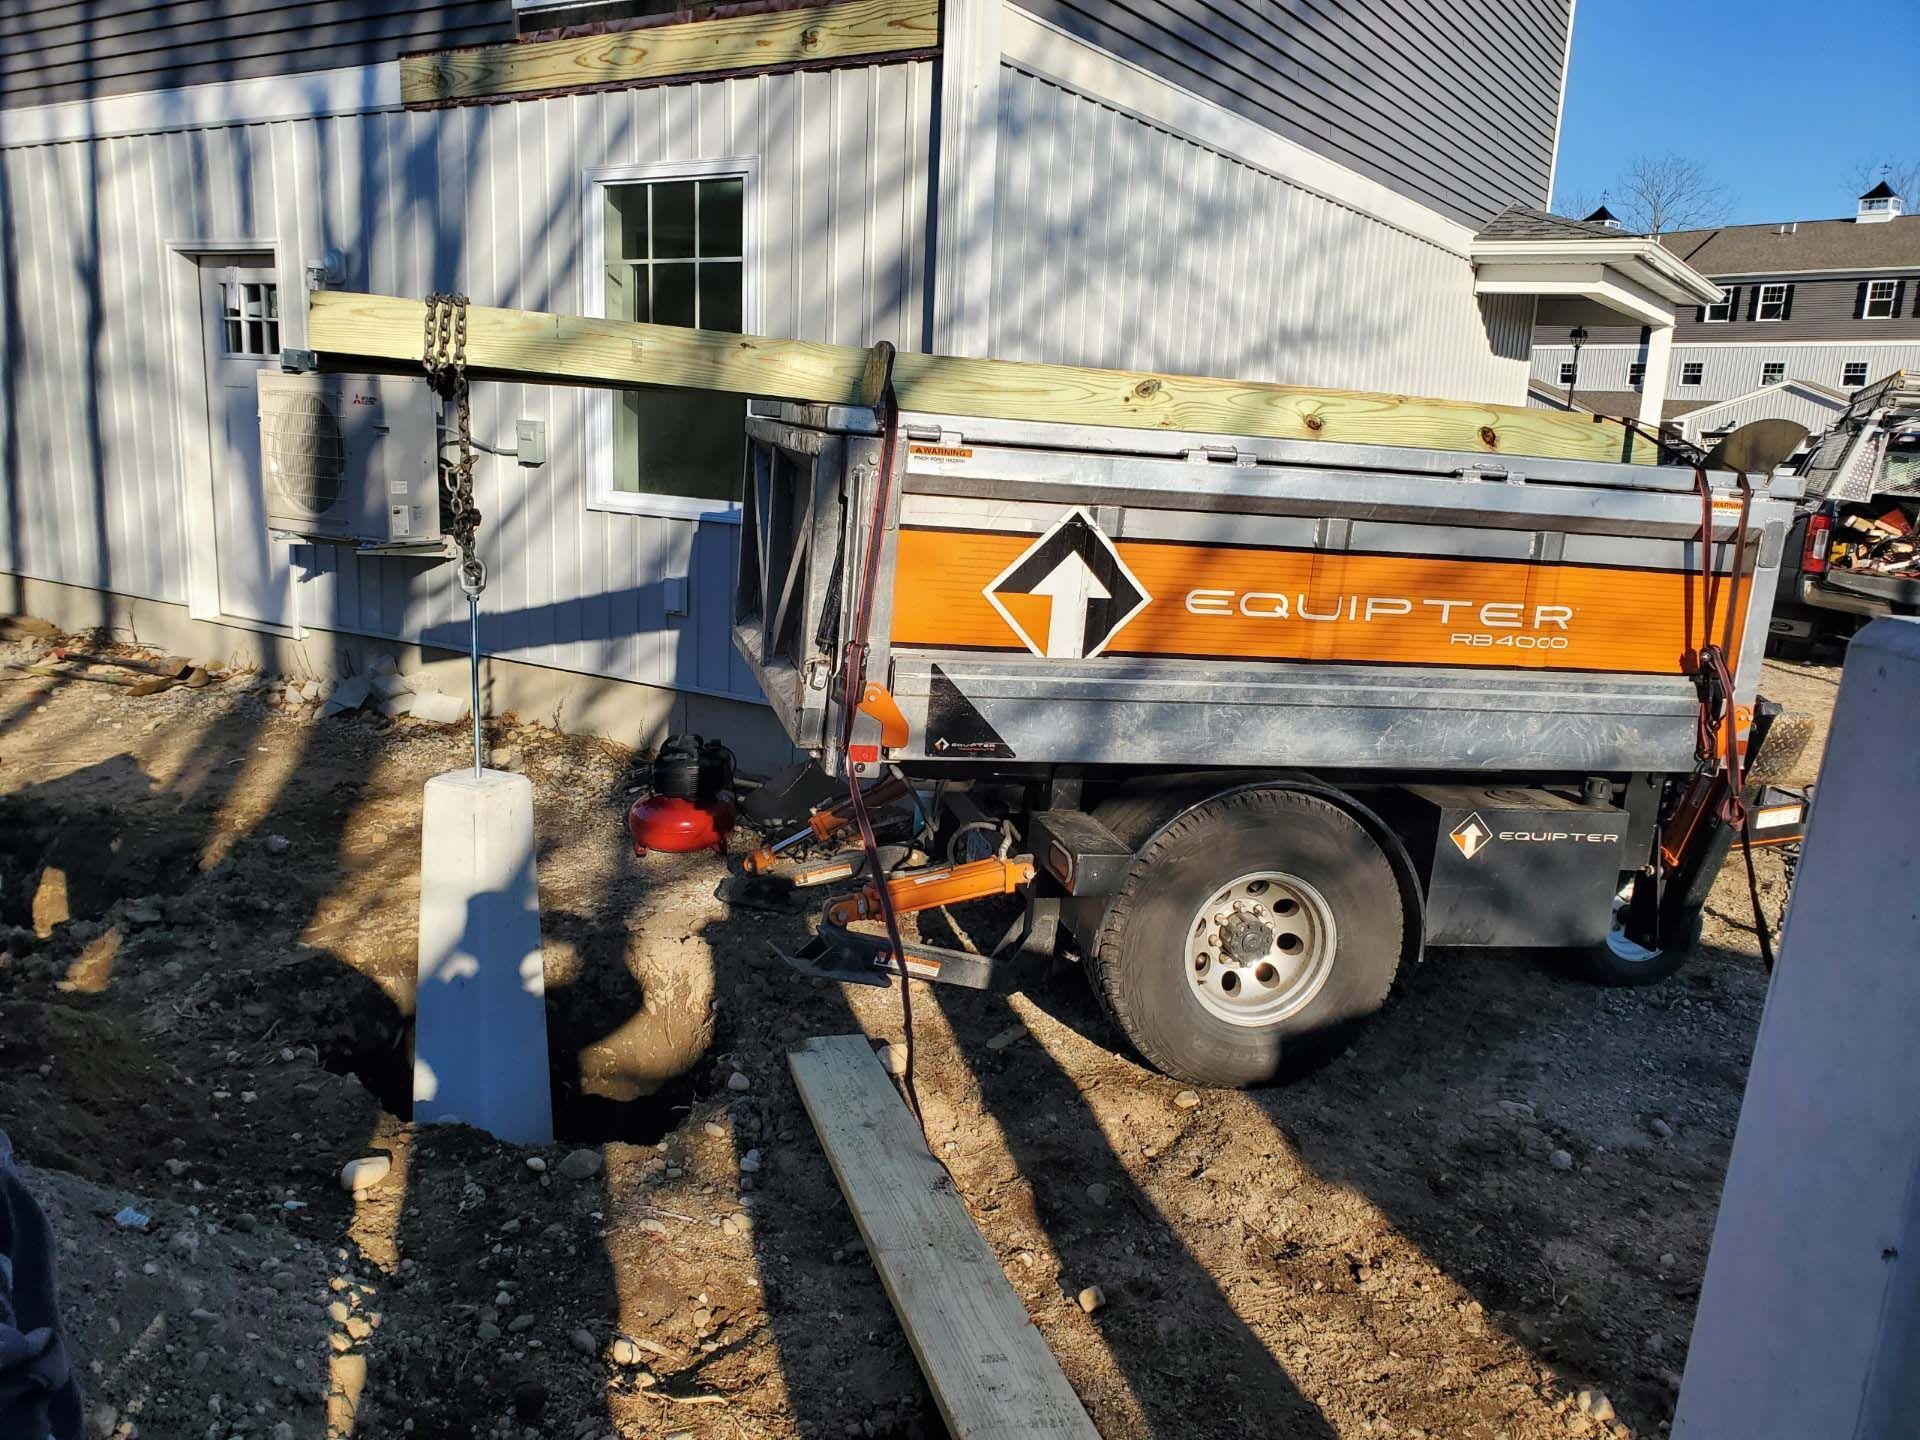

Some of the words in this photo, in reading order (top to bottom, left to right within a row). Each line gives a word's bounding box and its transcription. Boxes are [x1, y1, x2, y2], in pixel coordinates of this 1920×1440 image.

[923, 447, 966, 457] WARNING
[1185, 589, 1573, 630] EQUIPTER
[1450, 632, 1569, 649] RB4000
[1499, 831, 1618, 843] EQUIPTER
